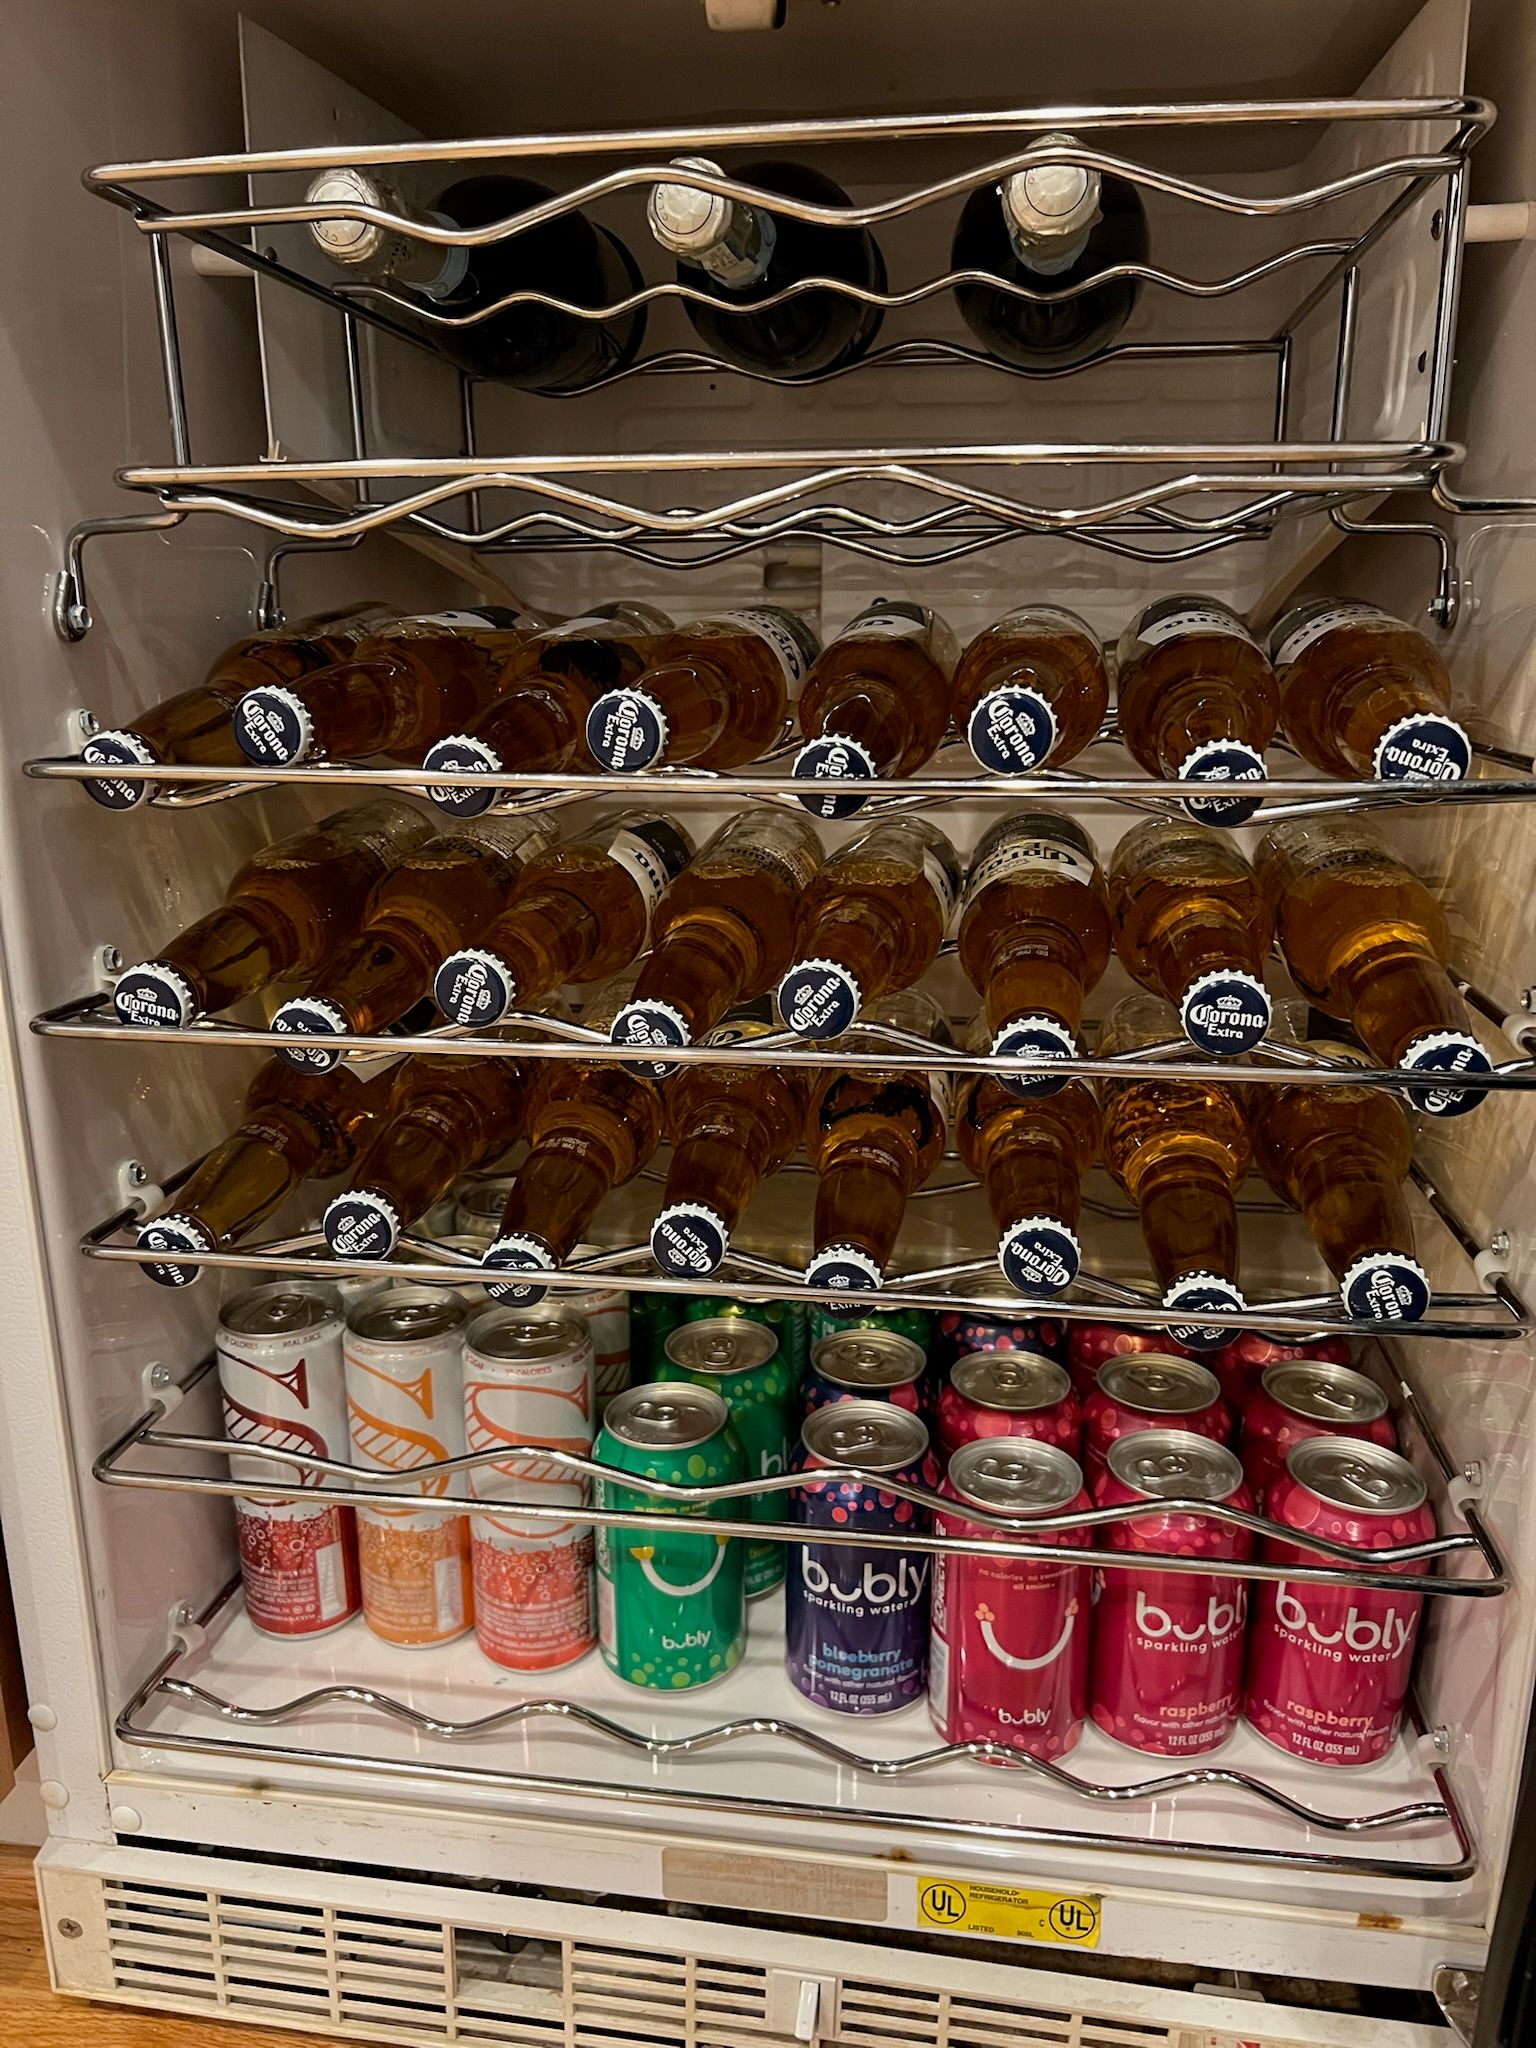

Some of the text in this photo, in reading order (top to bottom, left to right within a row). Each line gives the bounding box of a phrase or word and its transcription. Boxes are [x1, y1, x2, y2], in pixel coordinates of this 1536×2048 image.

[242, 700, 288, 762] Corona
[243, 723, 267, 754] Extra
[602, 714, 620, 748] Extra
[611, 700, 640, 769] Corona
[986, 727, 1010, 760] Extra
[988, 699, 1035, 767] Corona
[1386, 746, 1461, 780] Corona
[1411, 738, 1450, 763] Extra
[820, 746, 850, 815] Cona
[449, 974, 467, 1005] Extra
[456, 964, 487, 1024] Corona
[790, 976, 839, 1031] Corona
[115, 991, 178, 1022] Corona
[130, 1010, 161, 1027] Extra
[813, 1000, 841, 1028] Extra
[1189, 1003, 1265, 1028] Corona
[1206, 1025, 1244, 1040] Extra
[331, 1211, 381, 1254] Corona
[354, 1232, 380, 1254] Extra
[661, 1222, 712, 1272] Corona
[683, 1226, 708, 1252] Extra
[1011, 1241, 1070, 1286] Corona
[1033, 1241, 1063, 1267] Extra
[1366, 1289, 1383, 1319] Extra
[1371, 1270, 1403, 1319] Coron
[802, 1544, 930, 1606] bubly
[803, 1589, 908, 1618] sparkling water
[1276, 1580, 1418, 1660] bubly
[662, 1630, 711, 1650] bubly
[823, 1642, 901, 1663] blueberry
[1136, 1637, 1207, 1654] sparkling
[1274, 1624, 1391, 1663] sparkling water
[809, 1654, 914, 1680] pomegranate
[998, 1707, 1051, 1726] bubly
[1287, 1700, 1374, 1731] raspberry
[1168, 1736, 1178, 1746] 12
[1178, 1735, 1188, 1746] FL
[1292, 1732, 1302, 1743] 12
[1303, 1736, 1313, 1748] FL
[1313, 1740, 1324, 1751] OZ
[931, 1889, 960, 1918] UL
[969, 1892, 1029, 1905] REFRIGERATOR
[968, 1924, 995, 1933] LISTED
[1059, 1904, 1089, 1932] UL
